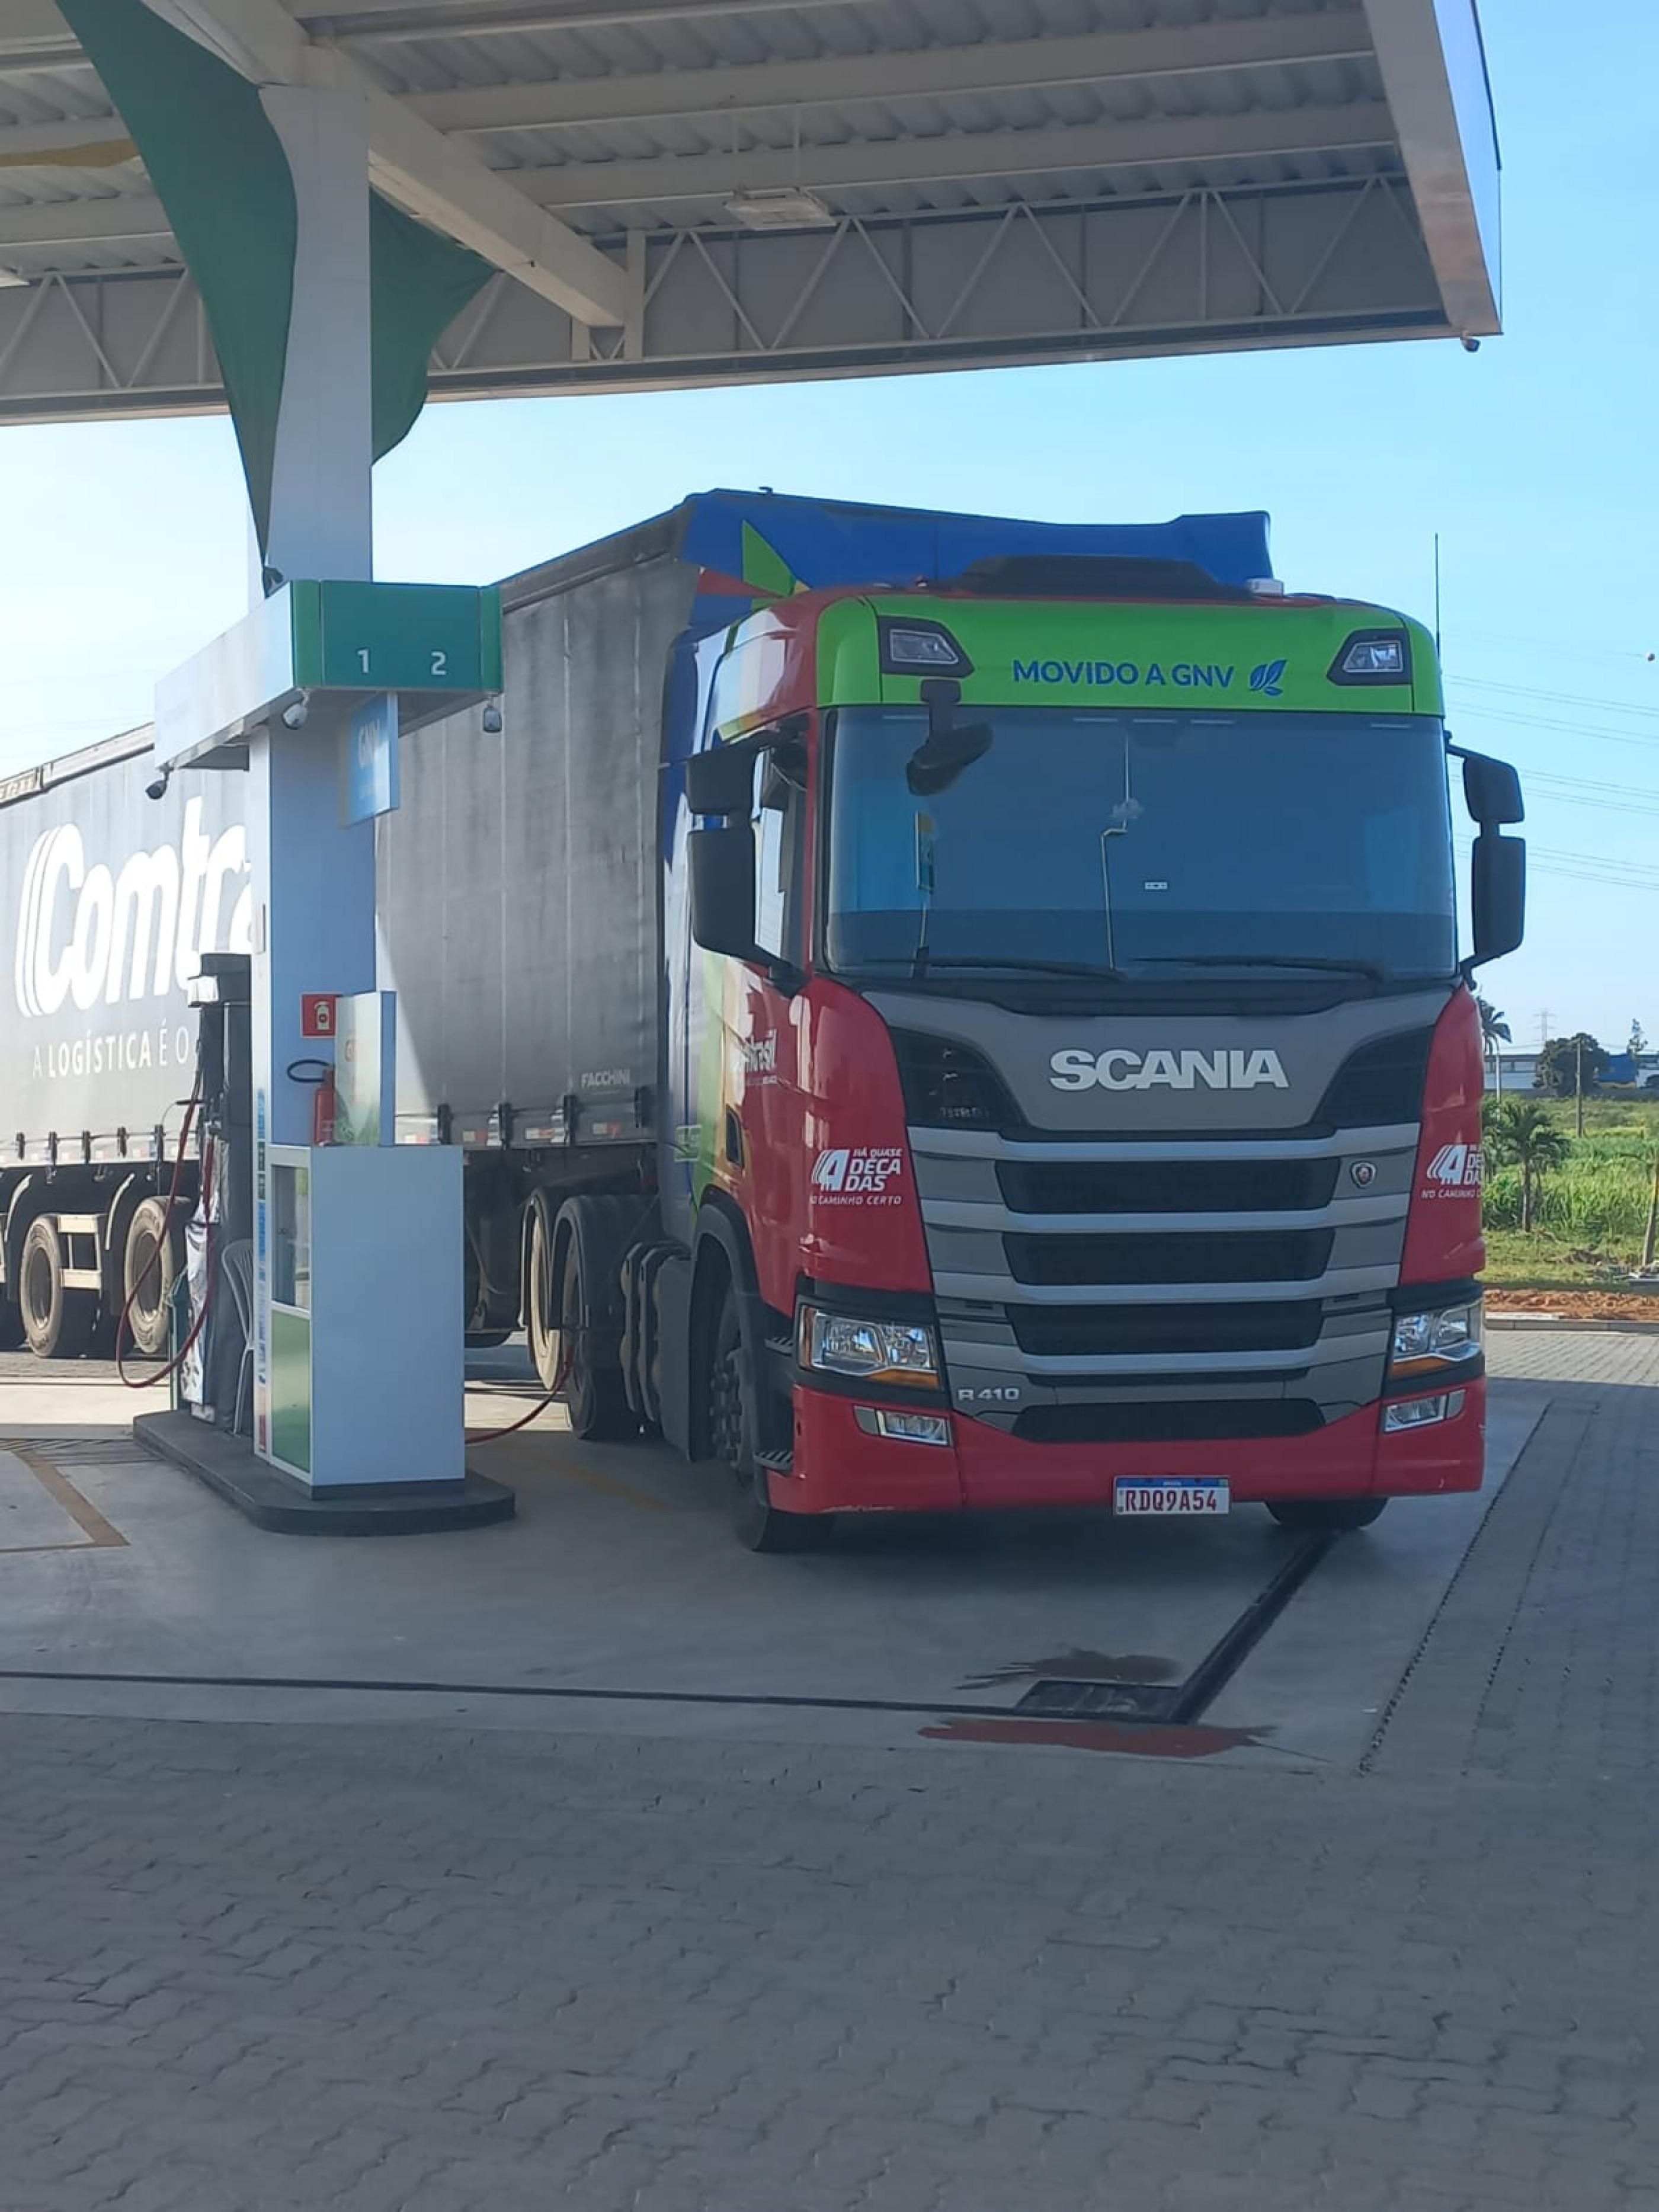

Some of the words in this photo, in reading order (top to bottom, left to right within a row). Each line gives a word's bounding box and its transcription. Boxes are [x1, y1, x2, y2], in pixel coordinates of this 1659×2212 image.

[357, 649, 370, 674] 1
[431, 651, 447, 676] 2
[1013, 660, 1139, 685] MOVIDO
[1145, 663, 1167, 686] A
[1171, 664, 1234, 687] GNV
[33, 1046, 43, 1078] A
[49, 1029, 152, 1078] LOGÍSTICA
[159, 1017, 168, 1066] É
[175, 1026, 189, 1064] O
[1050, 1049, 1290, 1091] SCANIA
[849, 1158, 901, 1174] DECA
[844, 1176, 888, 1192] DAS
[866, 1195, 902, 1205] CERTO
[957, 1389, 974, 1401] R
[976, 1388, 1019, 1400] 410
[1126, 1490, 1218, 1512] RDQ9A54
